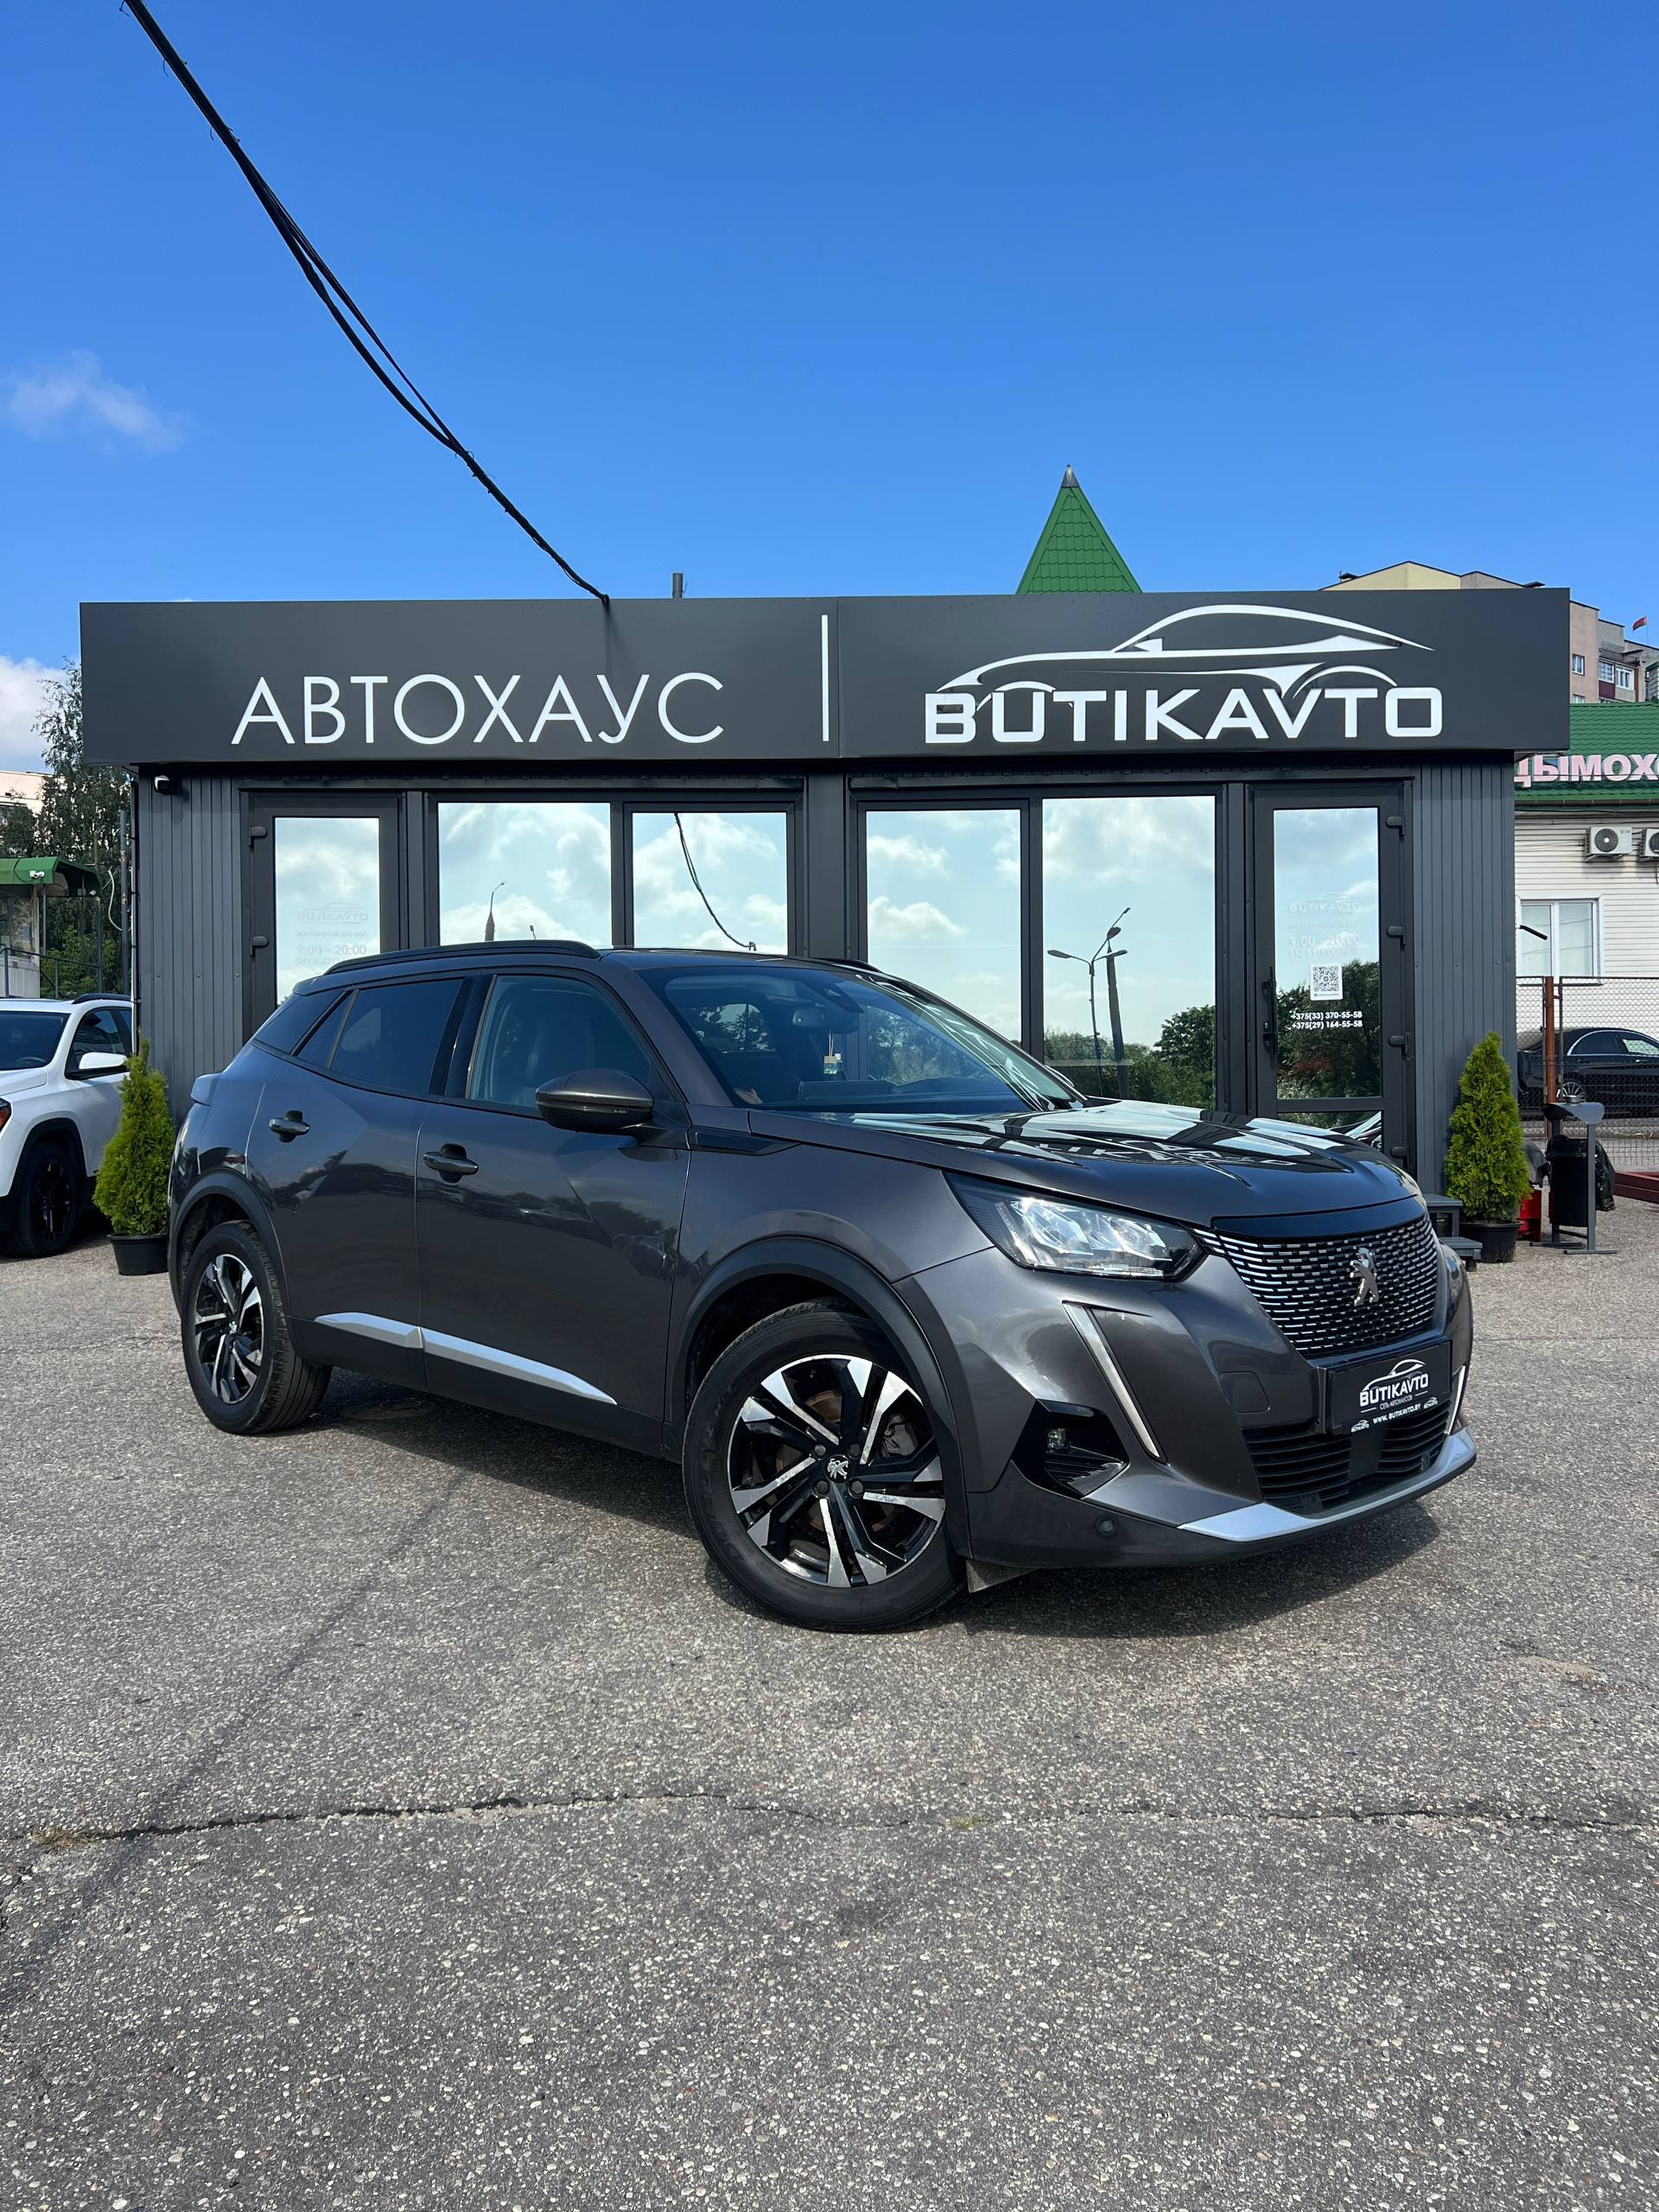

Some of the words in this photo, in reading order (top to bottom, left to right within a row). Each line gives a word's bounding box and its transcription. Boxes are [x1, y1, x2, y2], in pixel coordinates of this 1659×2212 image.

[231, 672, 724, 745] АВТОХАУС
[924, 686, 1443, 744] BUTIKAVTO
[1290, 1012, 1324, 1020] +375(33)
[1291, 1021, 1325, 1030] +375(29)
[1325, 1020, 1363, 1028] 164-55-58
[1359, 1374, 1429, 1407] BUTIKAVTO
